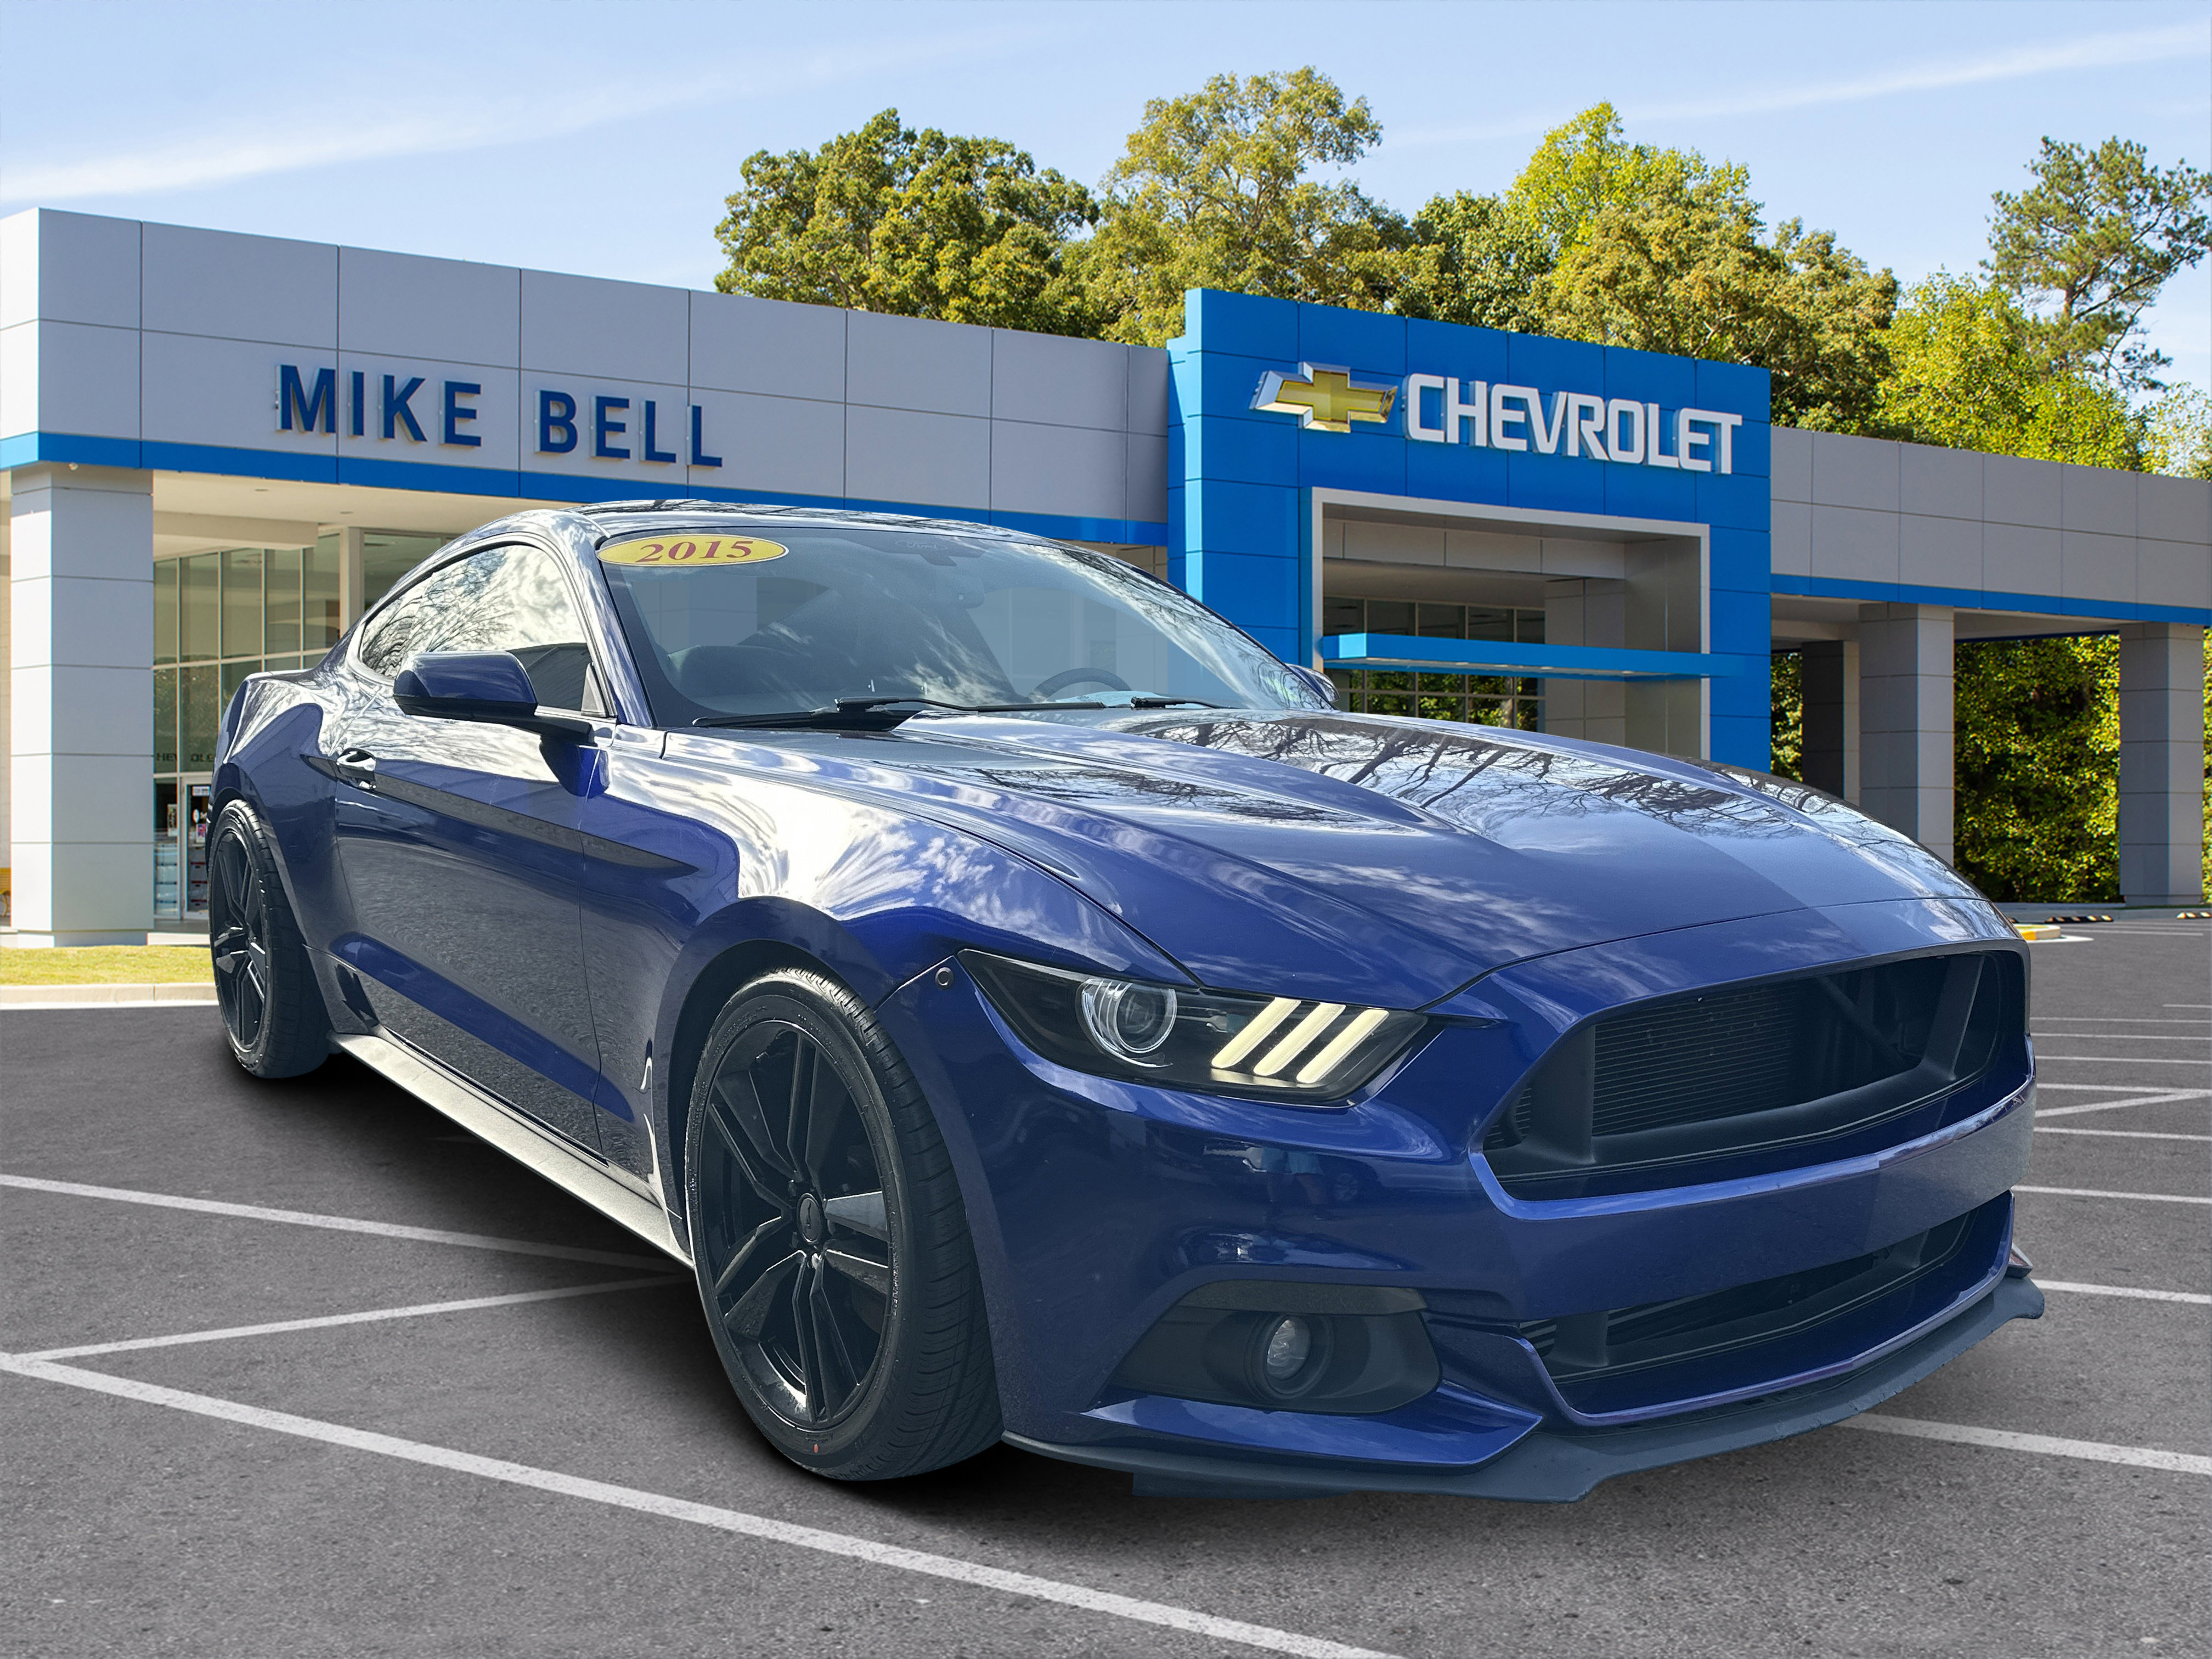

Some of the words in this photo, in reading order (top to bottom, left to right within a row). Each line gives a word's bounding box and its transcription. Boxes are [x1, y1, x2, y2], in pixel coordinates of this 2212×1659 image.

[277, 364, 481, 447] MIKE
[535, 390, 723, 468] BELL
[1404, 373, 1742, 475] CHEVROLET
[635, 540, 754, 563] 2015
